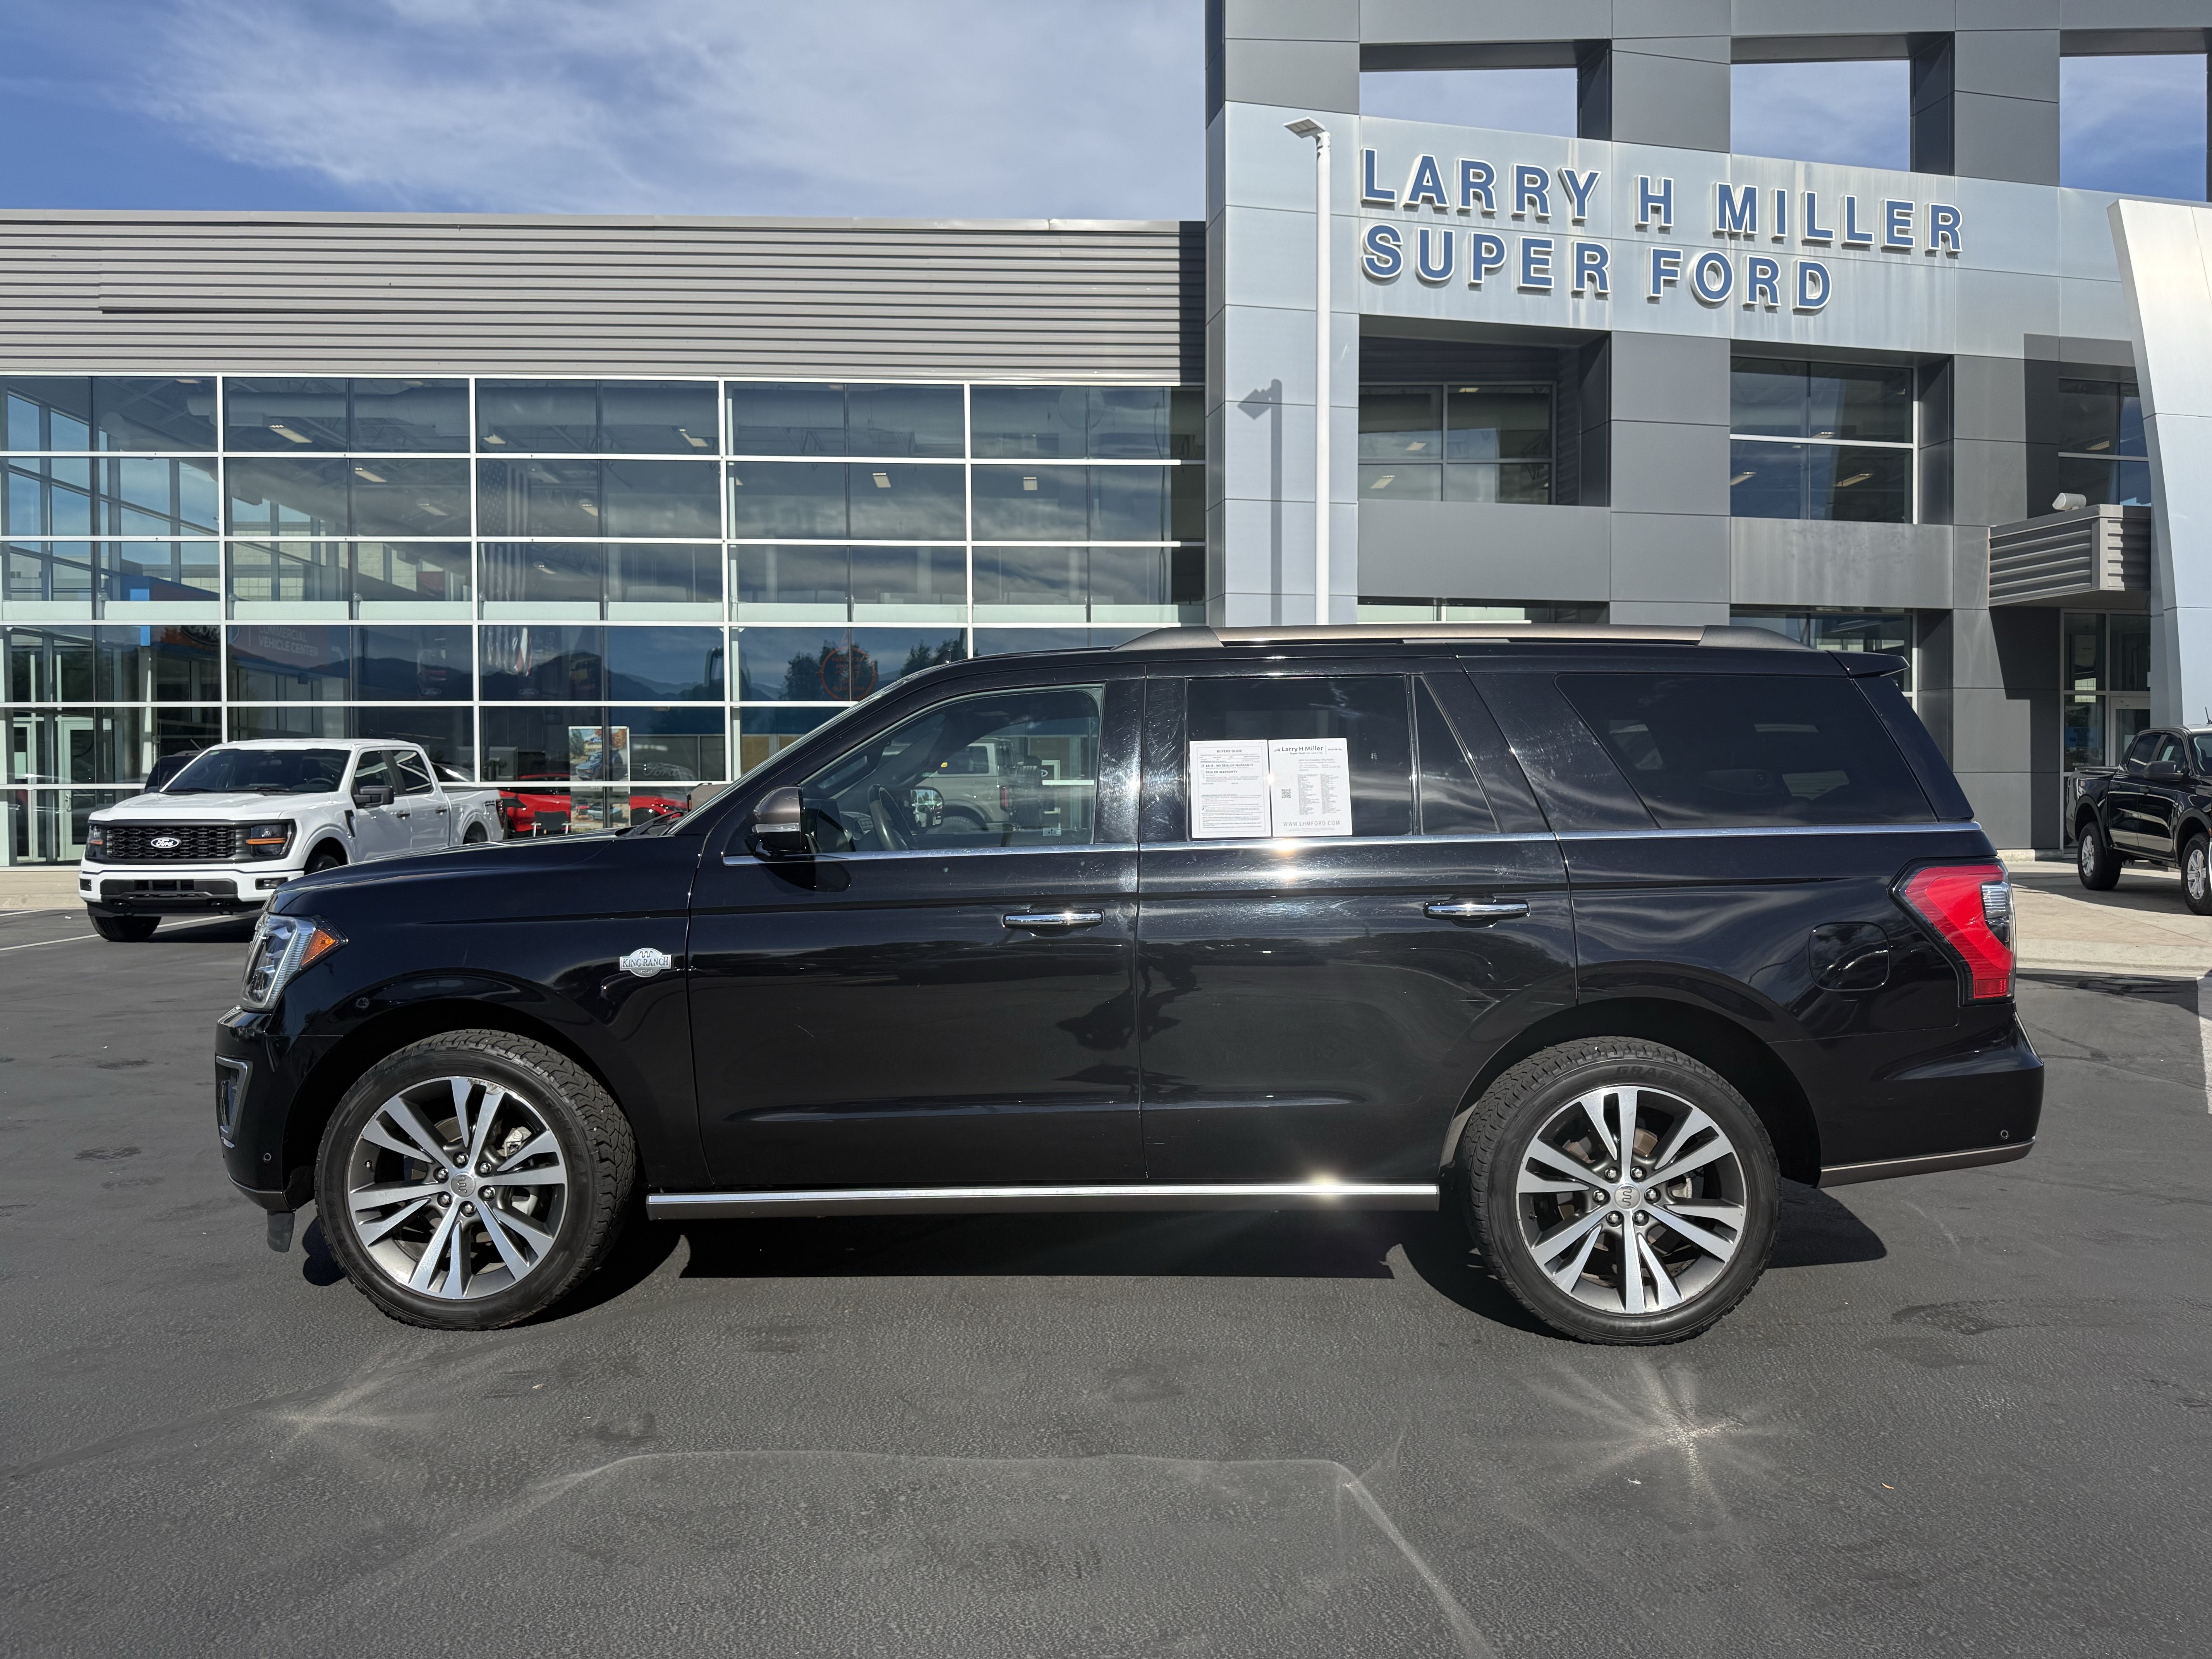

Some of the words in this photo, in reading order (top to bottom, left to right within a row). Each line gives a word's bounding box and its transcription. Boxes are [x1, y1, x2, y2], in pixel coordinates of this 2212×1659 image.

[1360, 147, 1601, 222] LARRY
[1636, 175, 1675, 228] H
[1713, 181, 1963, 253] MILLER
[1362, 223, 1611, 295] SUPER
[1647, 247, 1832, 311] FORD
[259, 635, 290, 651] VEHICLE
[290, 642, 319, 657] CENTER
[623, 958, 641, 967] KING
[643, 957, 668, 967] RANCH
